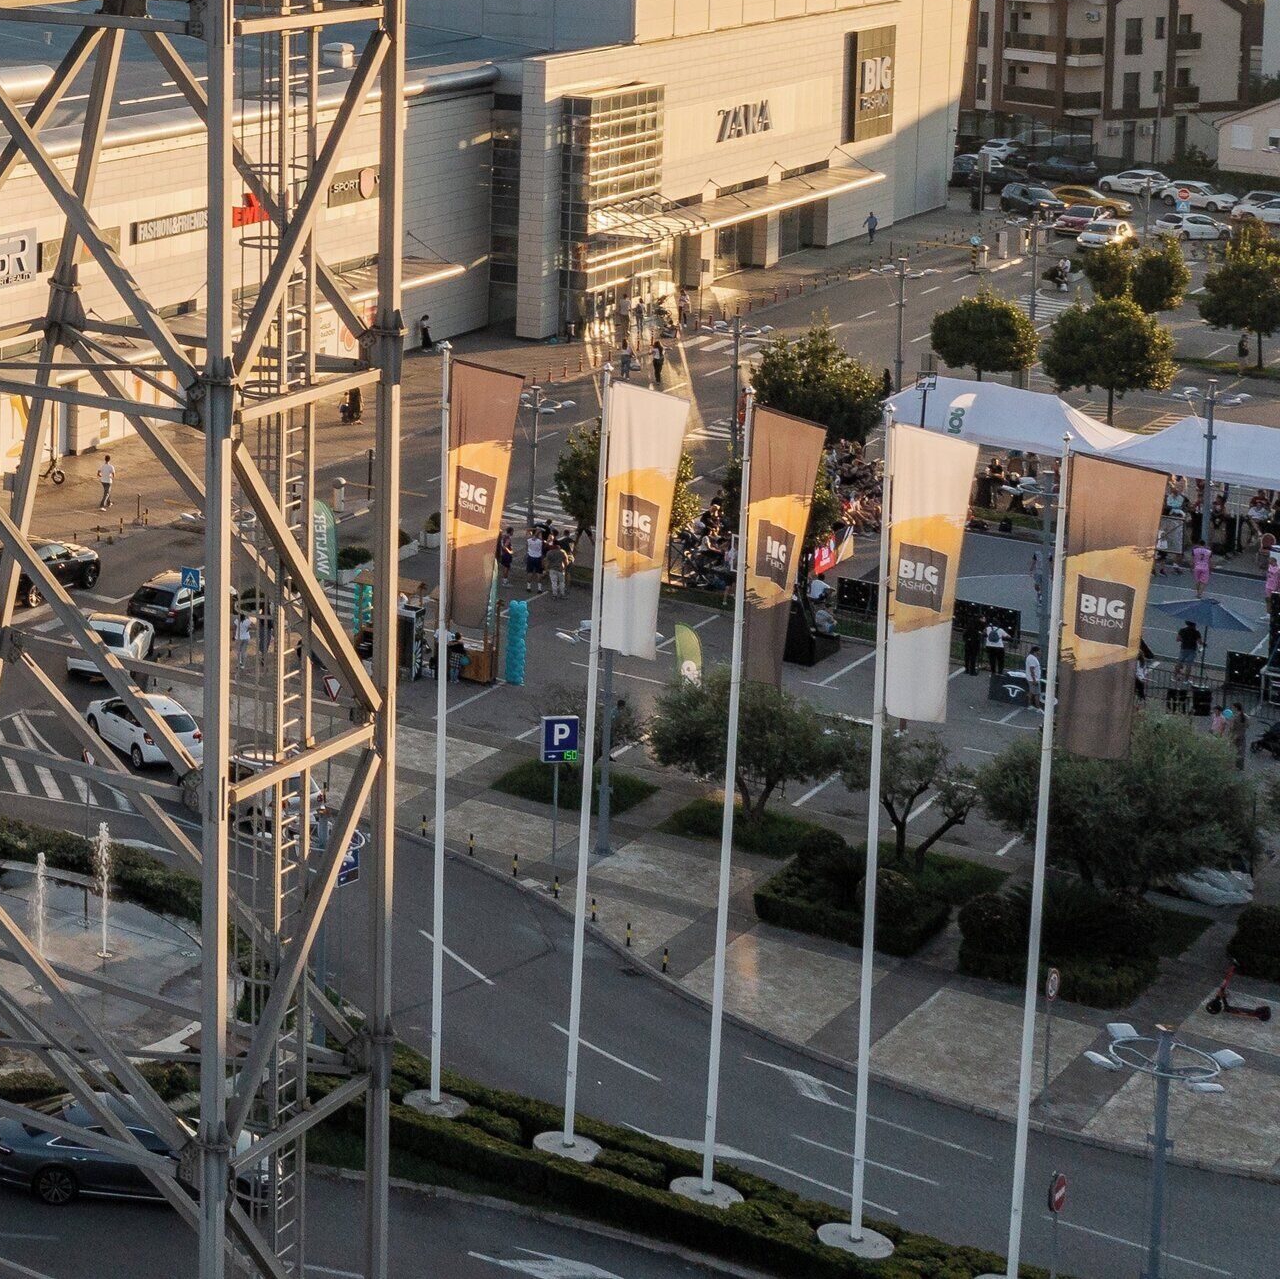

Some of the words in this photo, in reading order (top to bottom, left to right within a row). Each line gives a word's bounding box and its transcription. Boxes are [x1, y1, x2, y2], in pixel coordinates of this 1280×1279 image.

[863, 56, 892, 93] BIG
[333, 180, 359, 193] SPORT
[459, 480, 487, 506] BIG
[622, 509, 651, 533] BIG
[898, 559, 939, 585] BIG
[898, 578, 937, 594] FASHION
[1080, 593, 1126, 620] BIG
[554, 723, 570, 746] P
